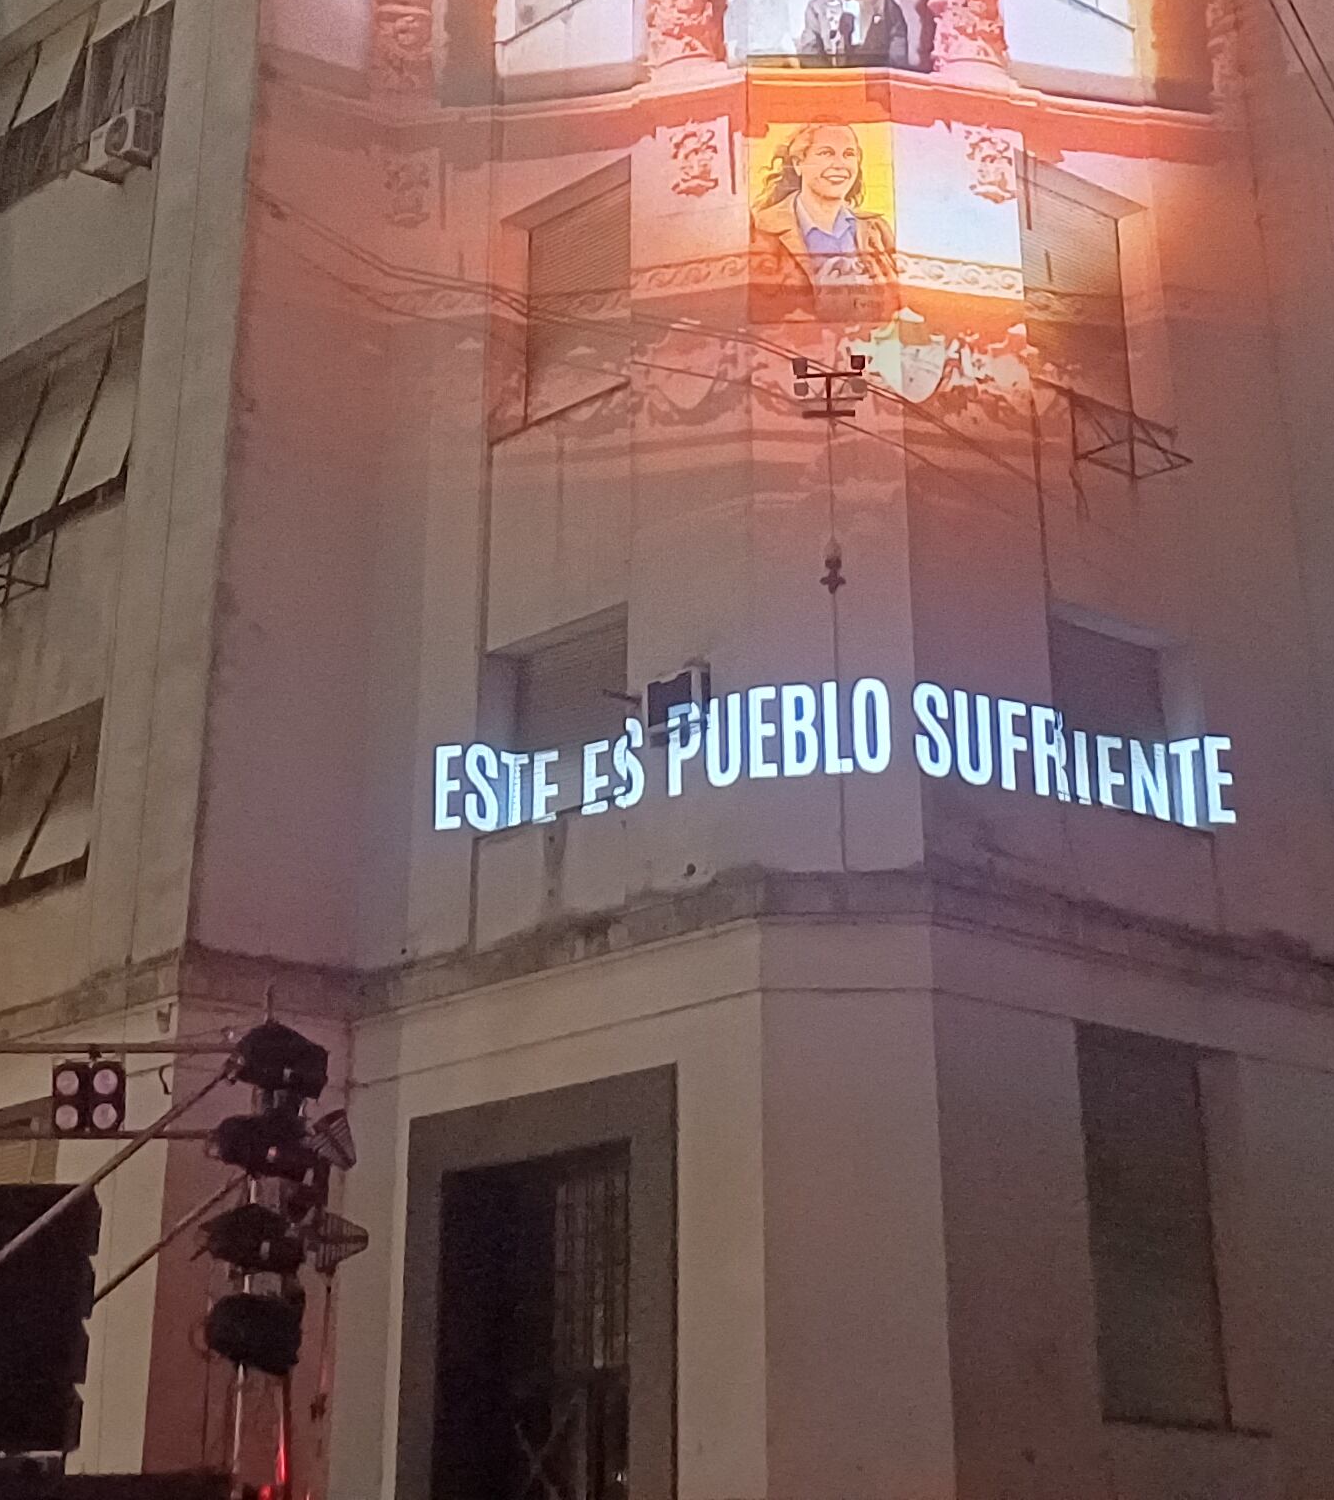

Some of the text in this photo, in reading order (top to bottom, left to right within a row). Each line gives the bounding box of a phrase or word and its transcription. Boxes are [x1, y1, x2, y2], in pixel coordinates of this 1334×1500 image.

[434, 677, 1237, 832] ESTE ES PUEBLO SUFRIENTE
